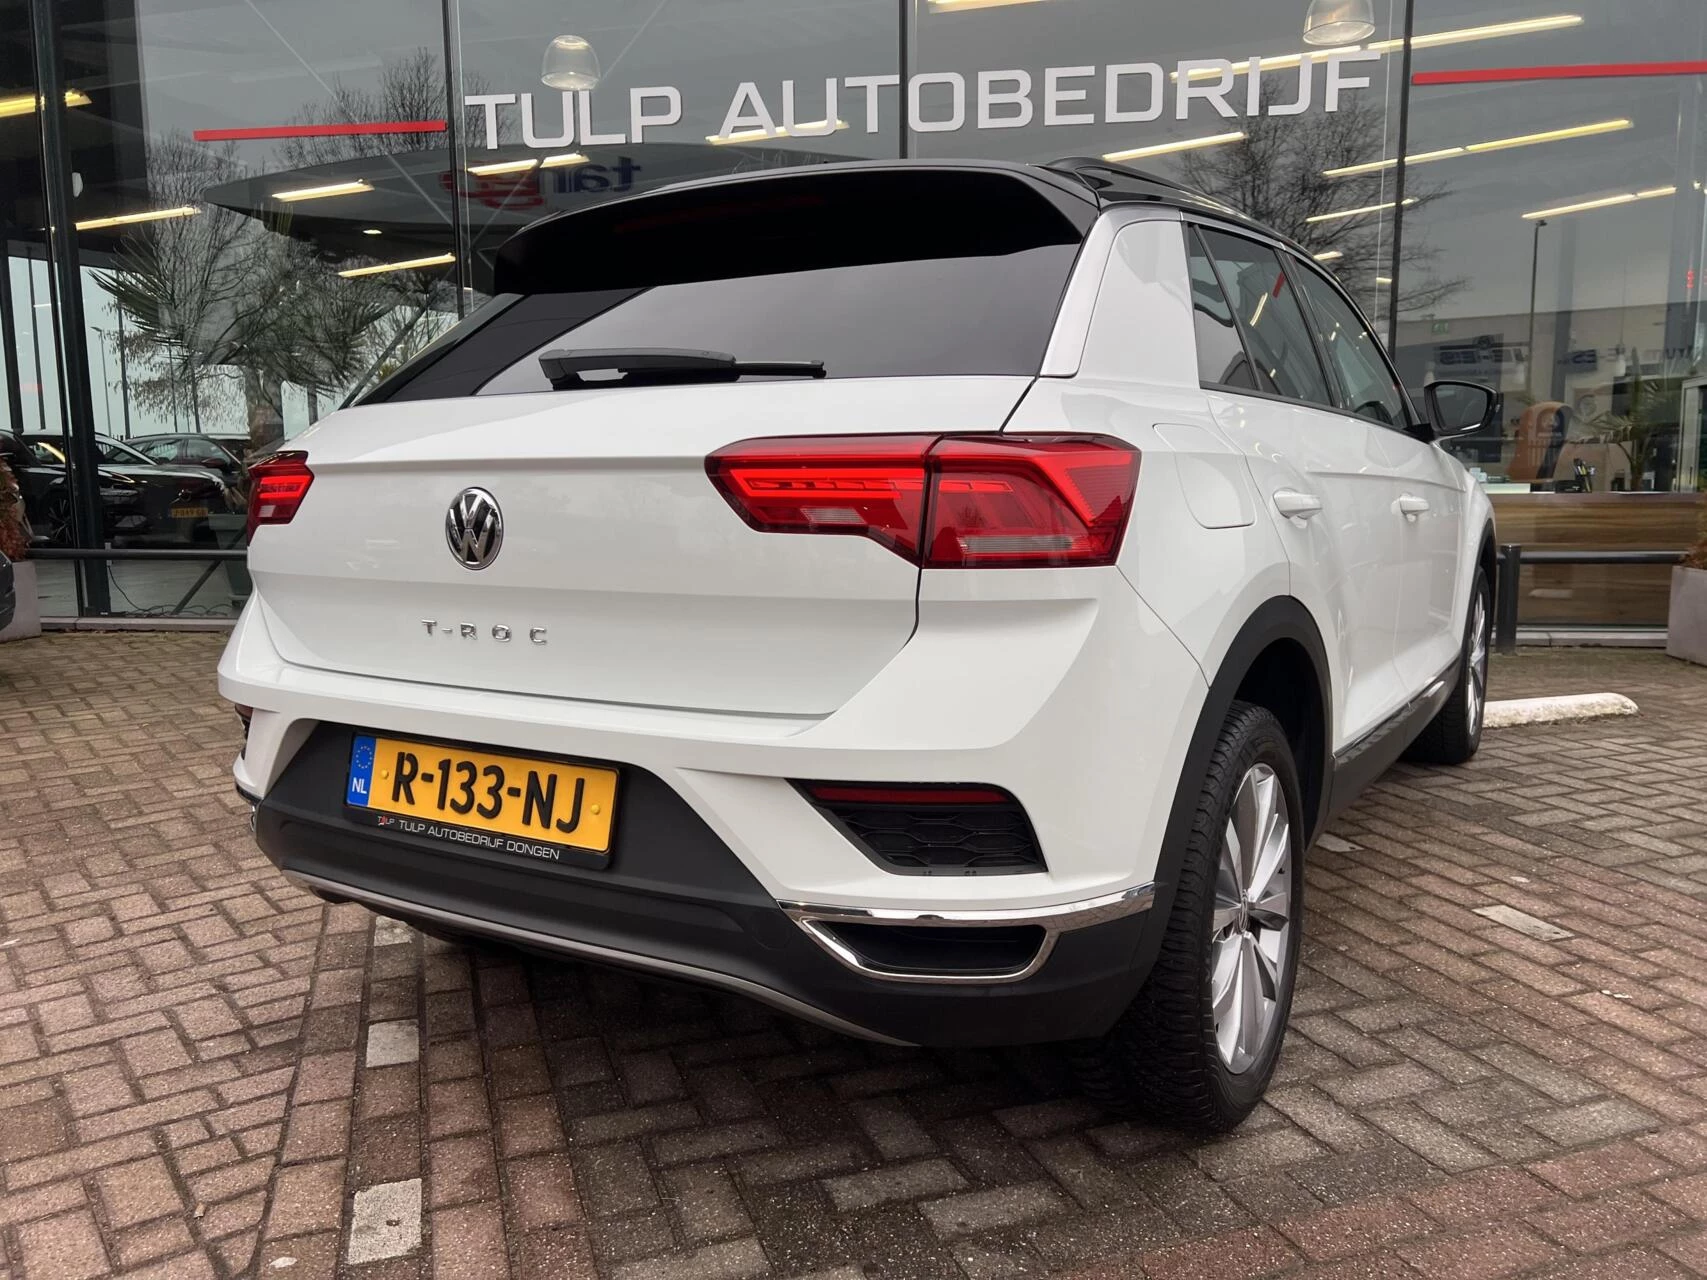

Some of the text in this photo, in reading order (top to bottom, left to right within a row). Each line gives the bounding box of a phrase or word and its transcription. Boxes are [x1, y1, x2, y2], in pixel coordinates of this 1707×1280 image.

[464, 50, 1381, 150] TULP AUTOBEDRIJF
[351, 776, 368, 794] NL
[391, 752, 585, 834] R-133-NJ
[399, 820, 425, 833] TULP
[427, 826, 504, 848] AUTOBEDRIJF
[506, 840, 560, 861] DONGEN
